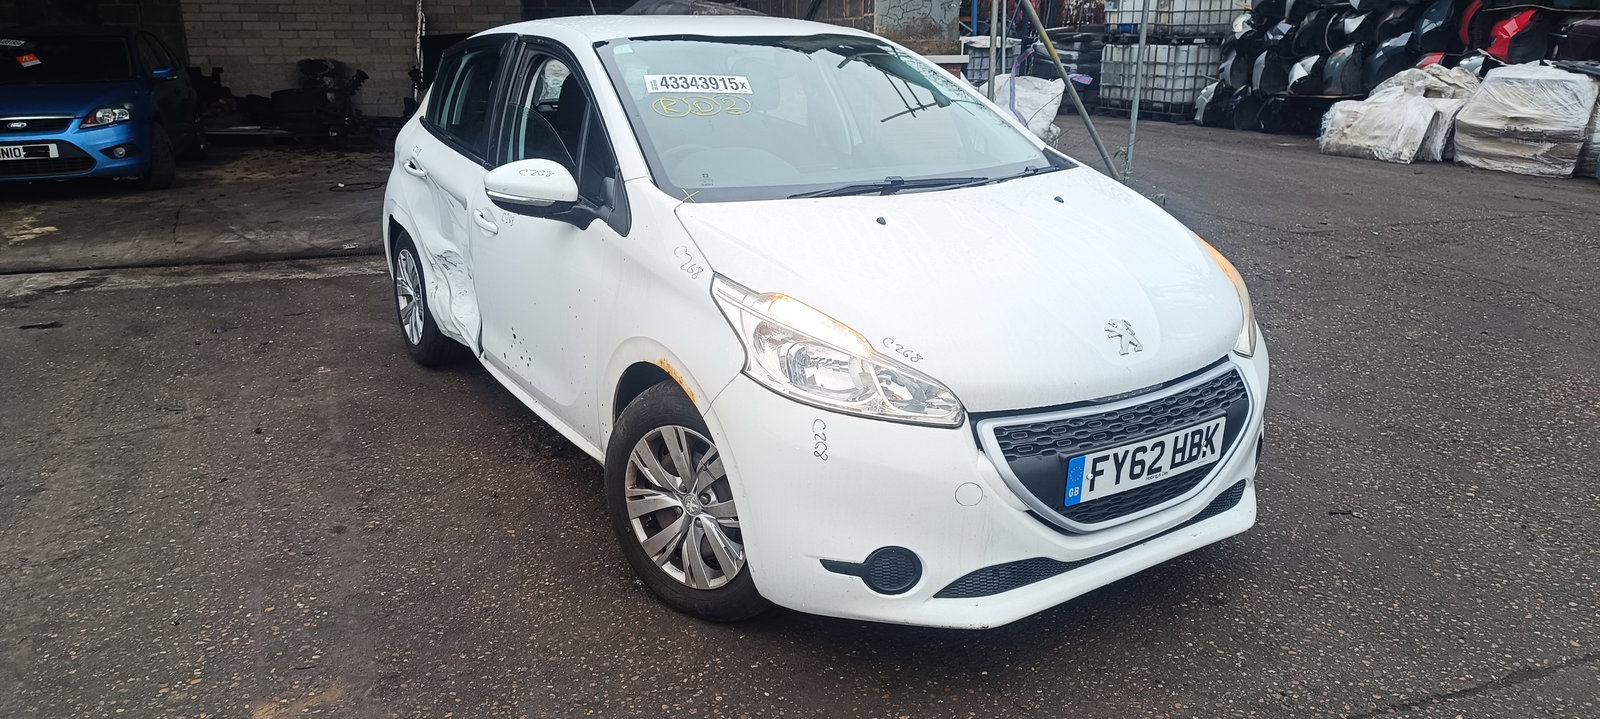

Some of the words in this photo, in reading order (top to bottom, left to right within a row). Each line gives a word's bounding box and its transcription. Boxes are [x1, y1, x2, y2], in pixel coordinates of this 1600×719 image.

[1088, 440, 1167, 492] FY62
[1169, 422, 1220, 471] HBK
[1068, 487, 1080, 498] GB
